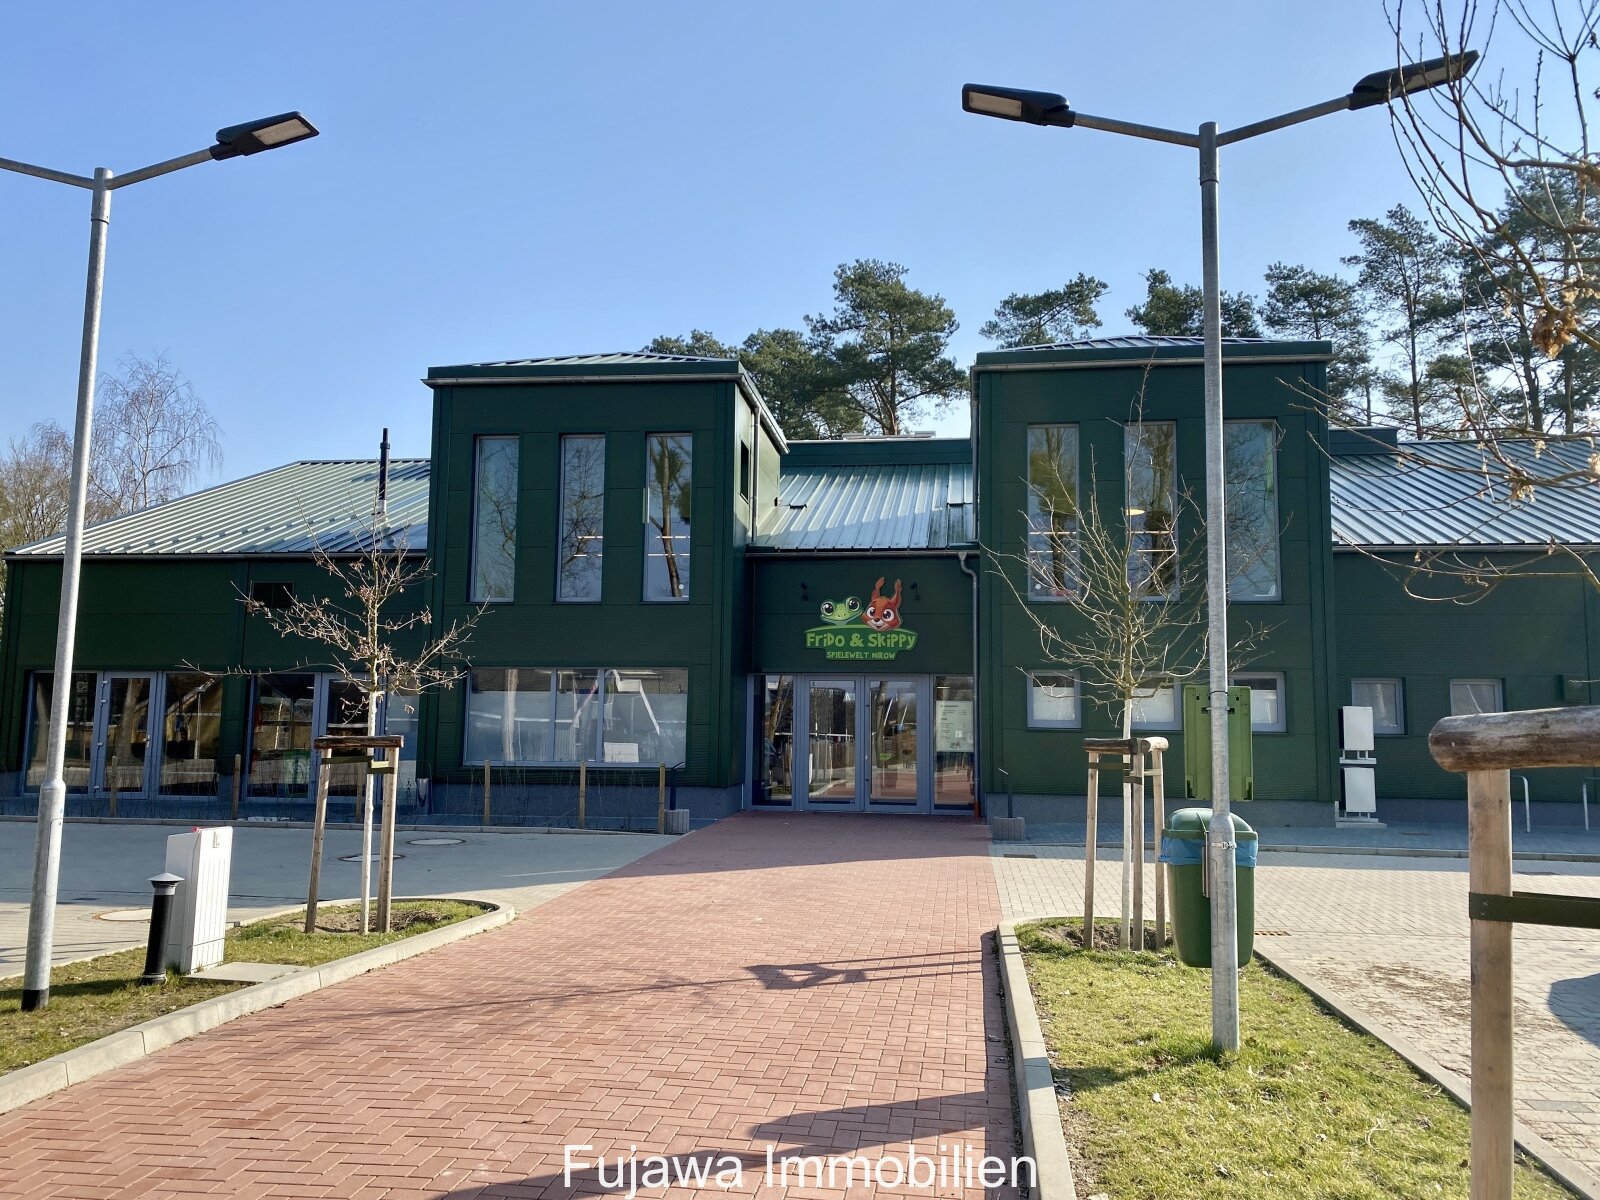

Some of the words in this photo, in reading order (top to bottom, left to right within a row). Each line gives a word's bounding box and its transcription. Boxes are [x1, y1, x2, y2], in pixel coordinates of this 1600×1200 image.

[849, 632, 865, 648] &
[826, 651, 868, 660] SPIELEWELT
[871, 651, 896, 660] MIROW
